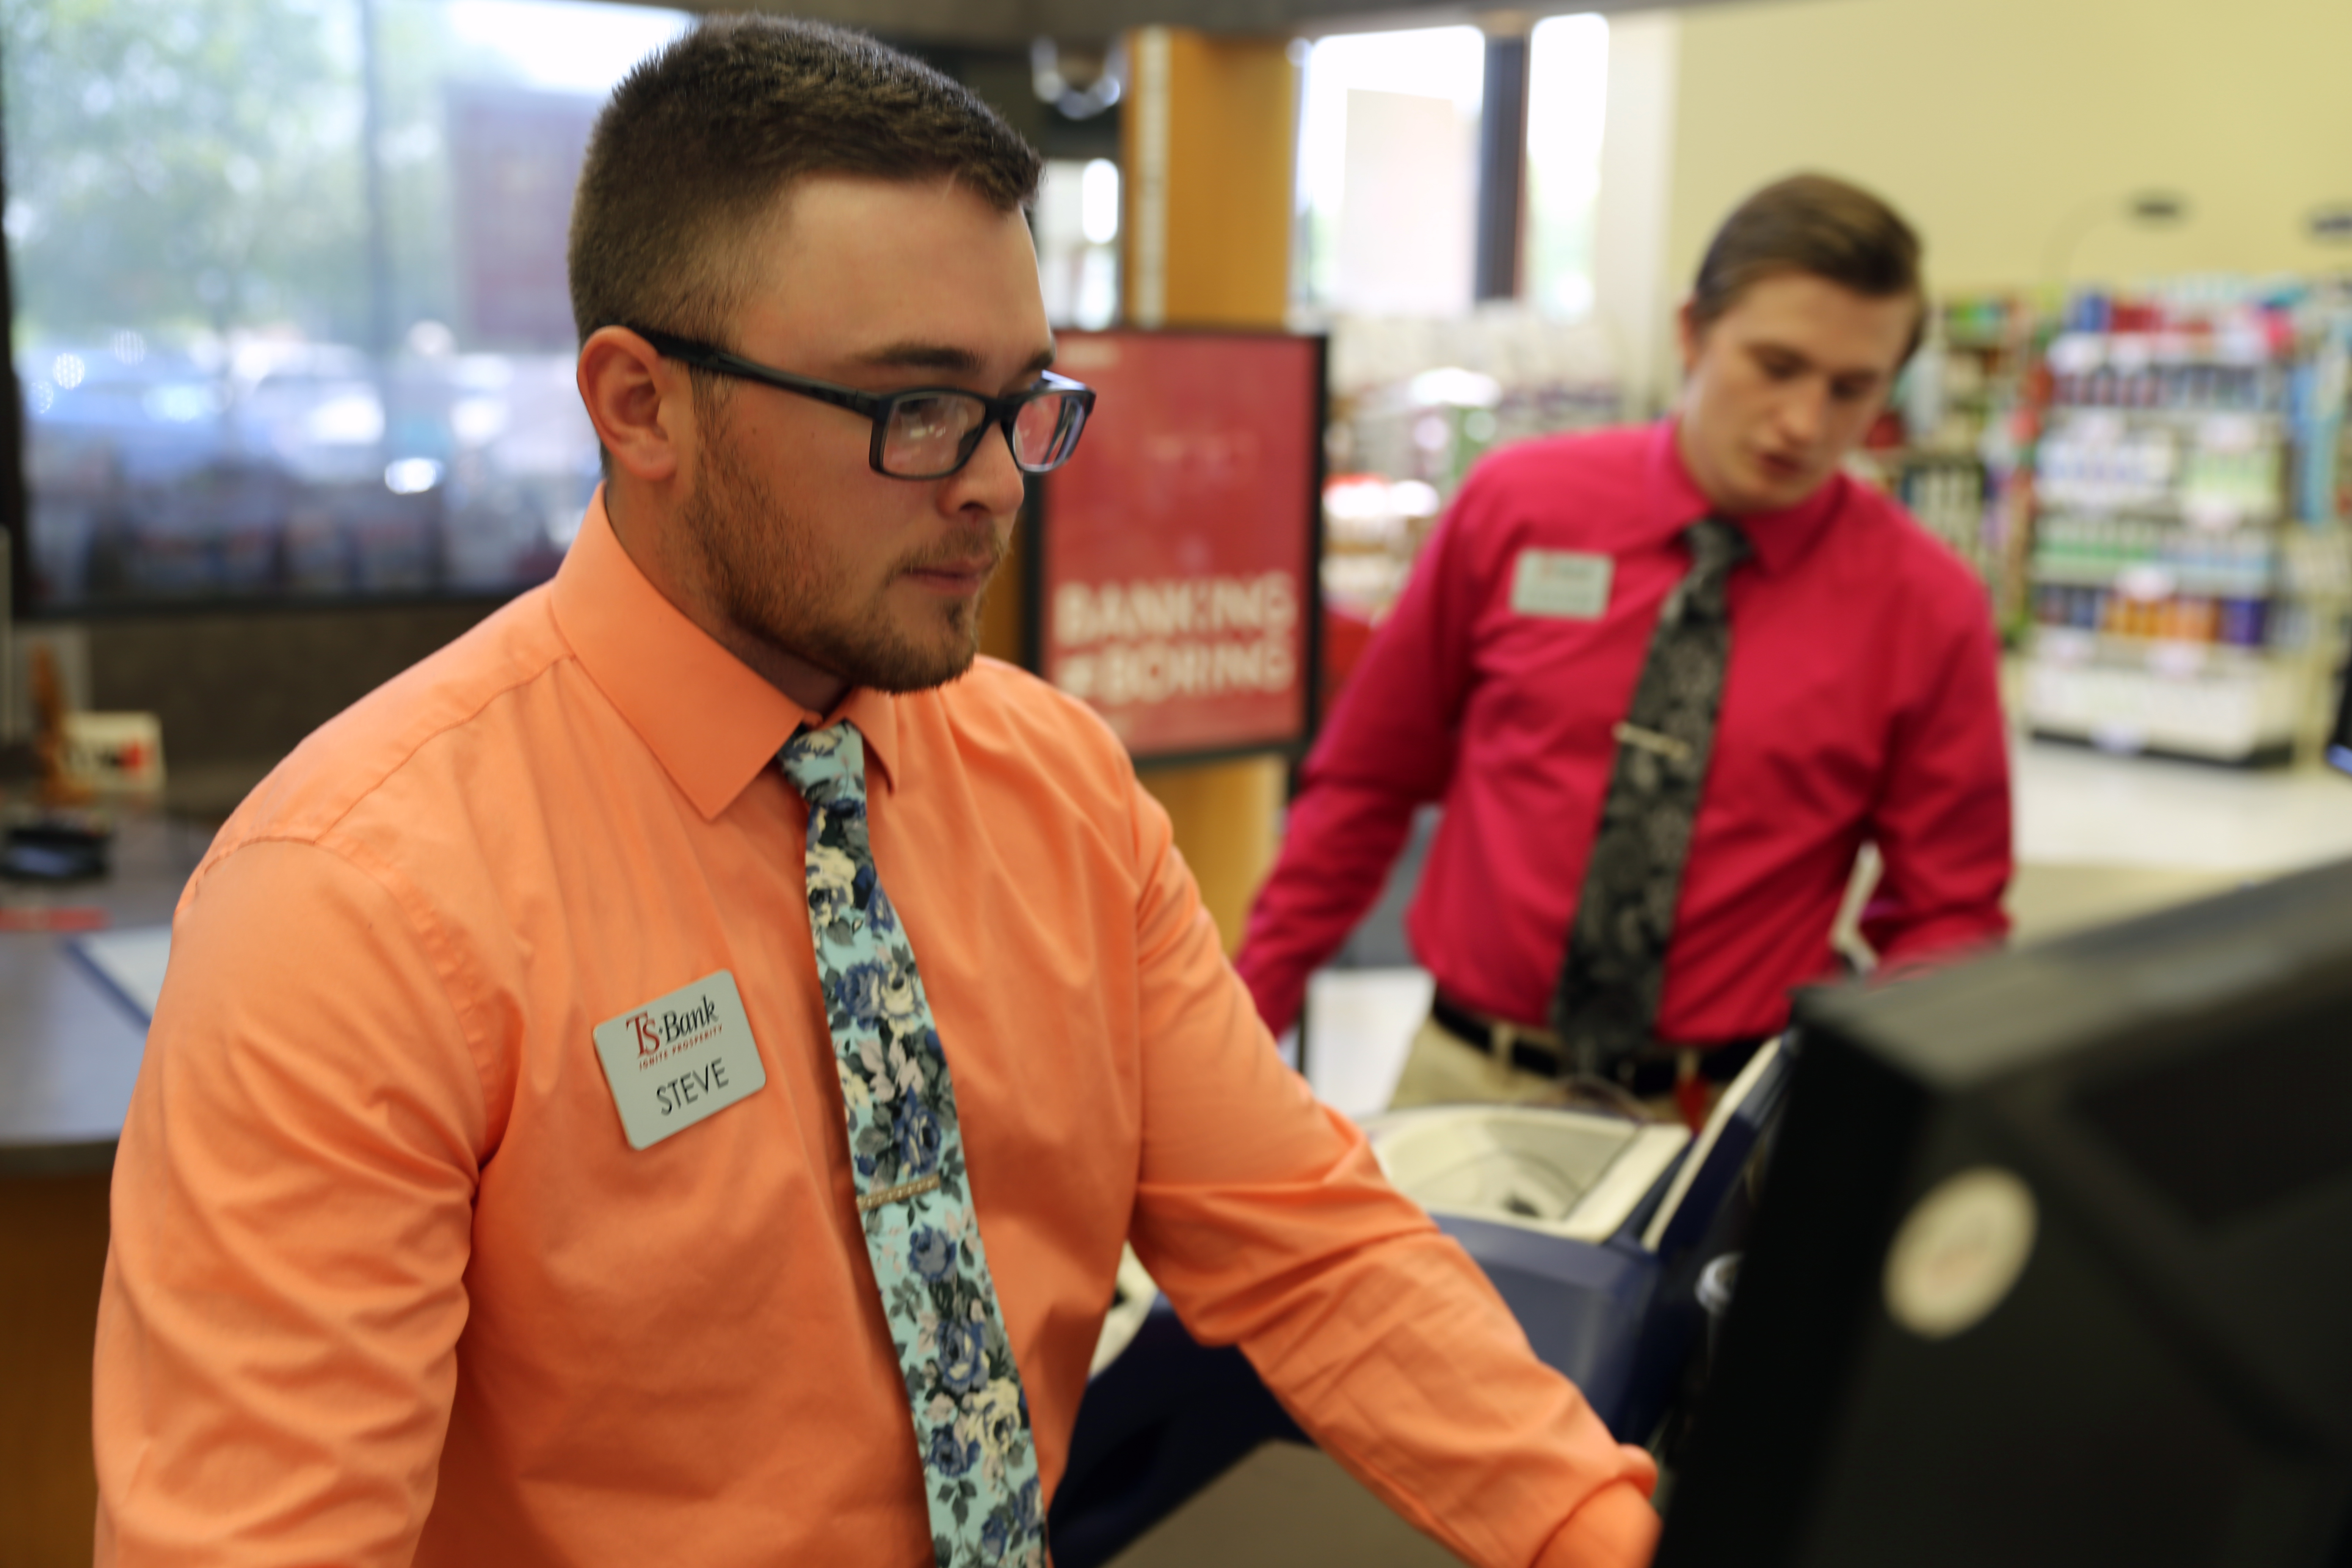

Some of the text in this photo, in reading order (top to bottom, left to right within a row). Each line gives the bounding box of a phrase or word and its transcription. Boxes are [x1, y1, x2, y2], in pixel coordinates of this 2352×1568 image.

[1055, 570, 1296, 649] BANKING
[639, 1023, 723, 1072] IGNITE PROSPERITY
[656, 1057, 729, 1116] STEVE
